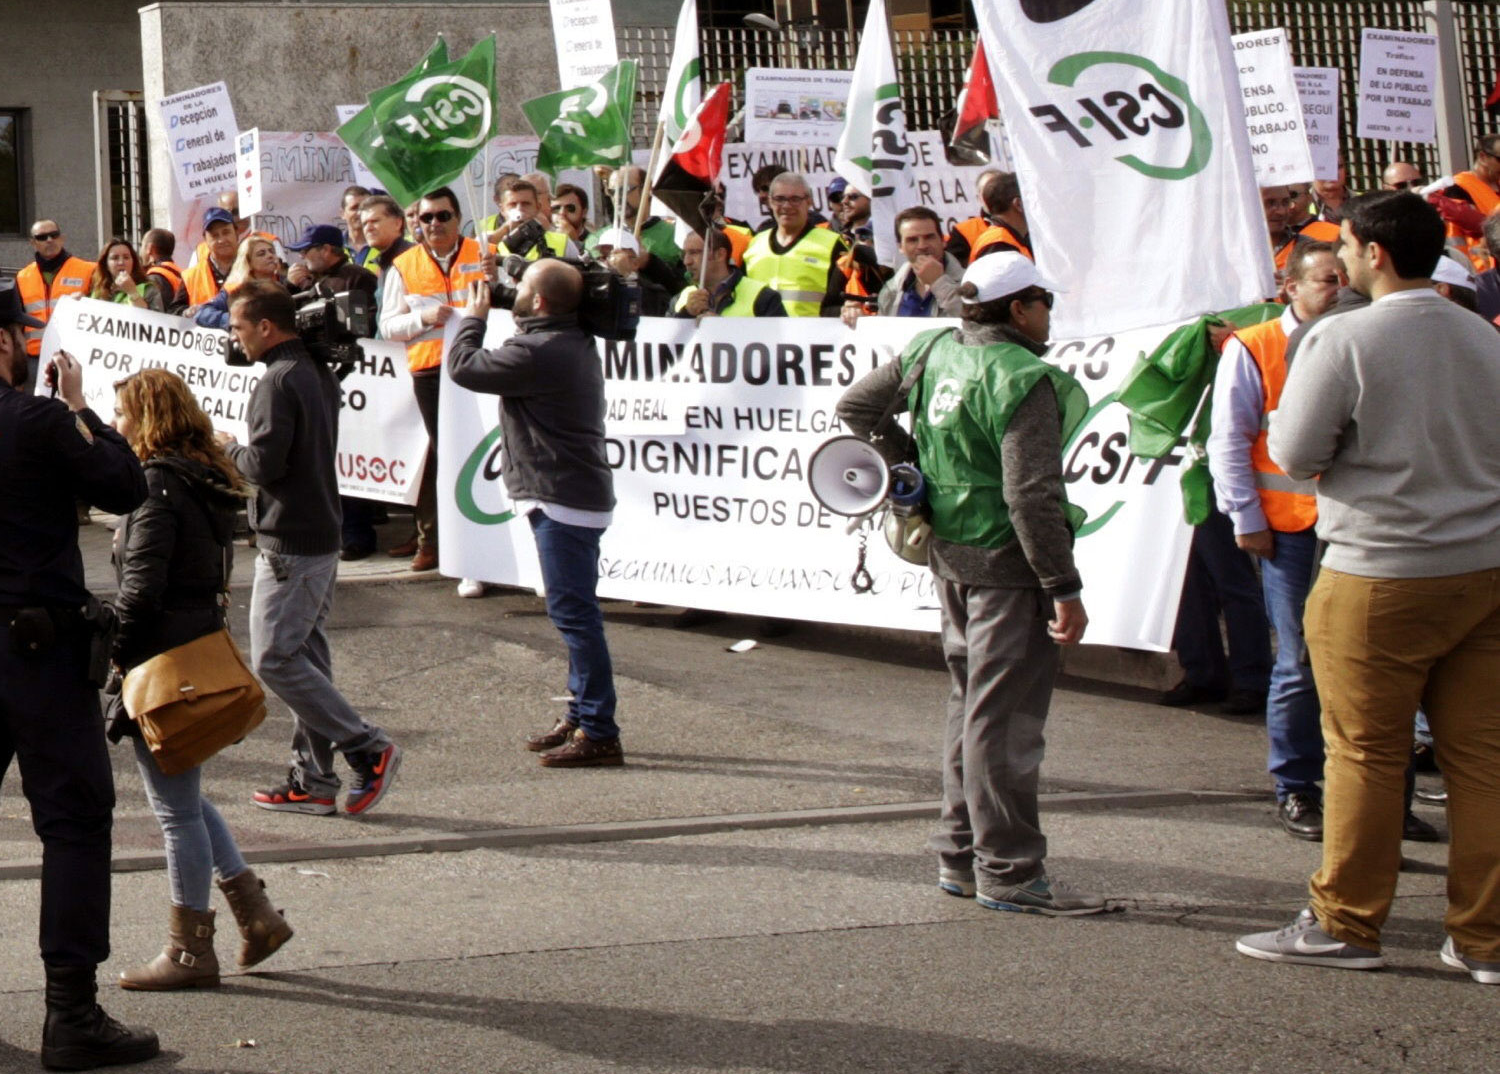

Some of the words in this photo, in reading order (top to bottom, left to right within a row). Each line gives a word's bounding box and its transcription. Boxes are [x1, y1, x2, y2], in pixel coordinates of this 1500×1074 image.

[1233, 36, 1280, 50] DORES
[160, 86, 222, 107] EXAMINADORES
[1241, 85, 1275, 98] ENSA
[176, 130, 213, 152] General
[214, 129, 226, 142] de
[1252, 143, 1268, 155] NO
[728, 147, 838, 179] EXAMINAD
[189, 178, 202, 188] EN
[88, 347, 133, 373] POR
[604, 340, 856, 387] MINADORES
[202, 396, 248, 423] CALI
[632, 397, 669, 421] REAL
[684, 405, 722, 430] EN
[733, 407, 843, 434] HUELGA
[653, 491, 787, 527] PUESTOS
[797, 501, 832, 530] DE
